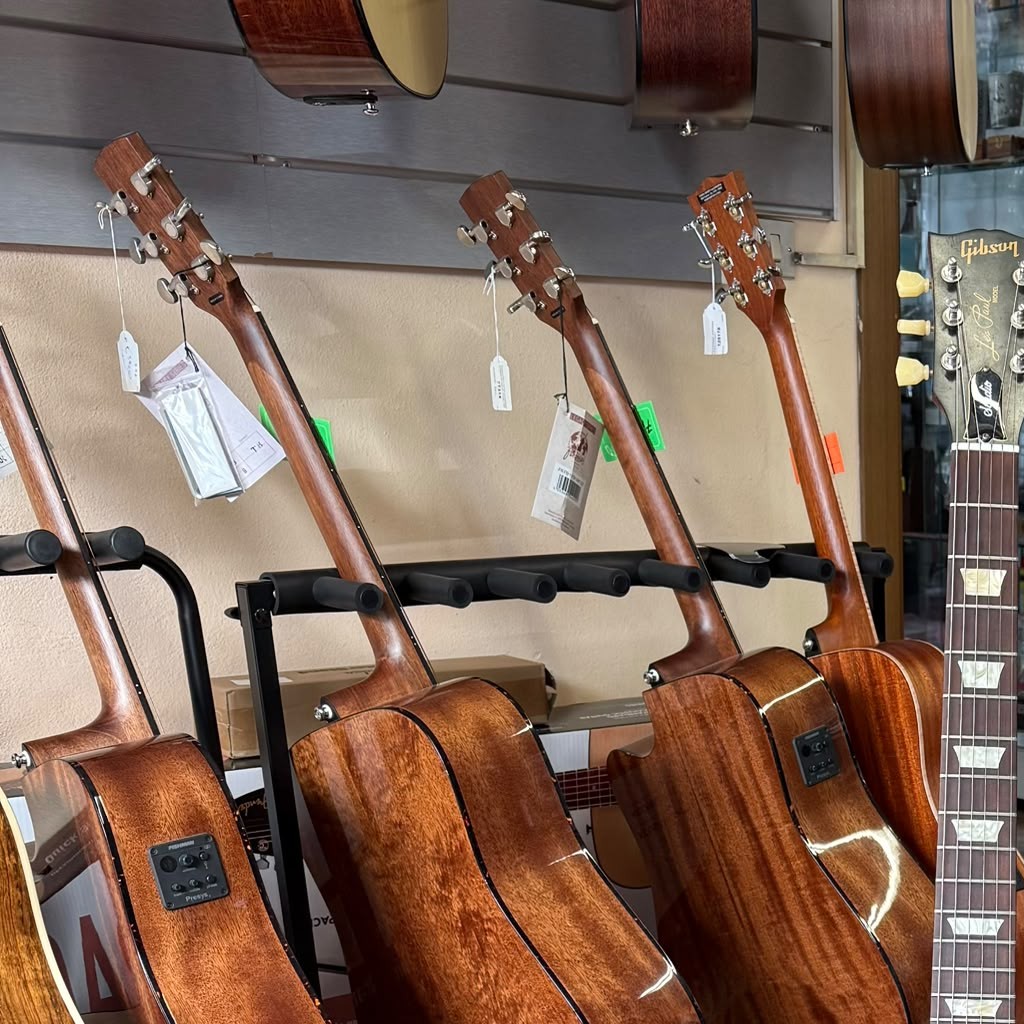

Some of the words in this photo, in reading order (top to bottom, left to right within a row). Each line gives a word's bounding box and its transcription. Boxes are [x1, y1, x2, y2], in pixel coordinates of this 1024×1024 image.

[960, 238, 1020, 265] Gibson
[970, 292, 994, 328] Paul
[973, 329, 1000, 361] Les
